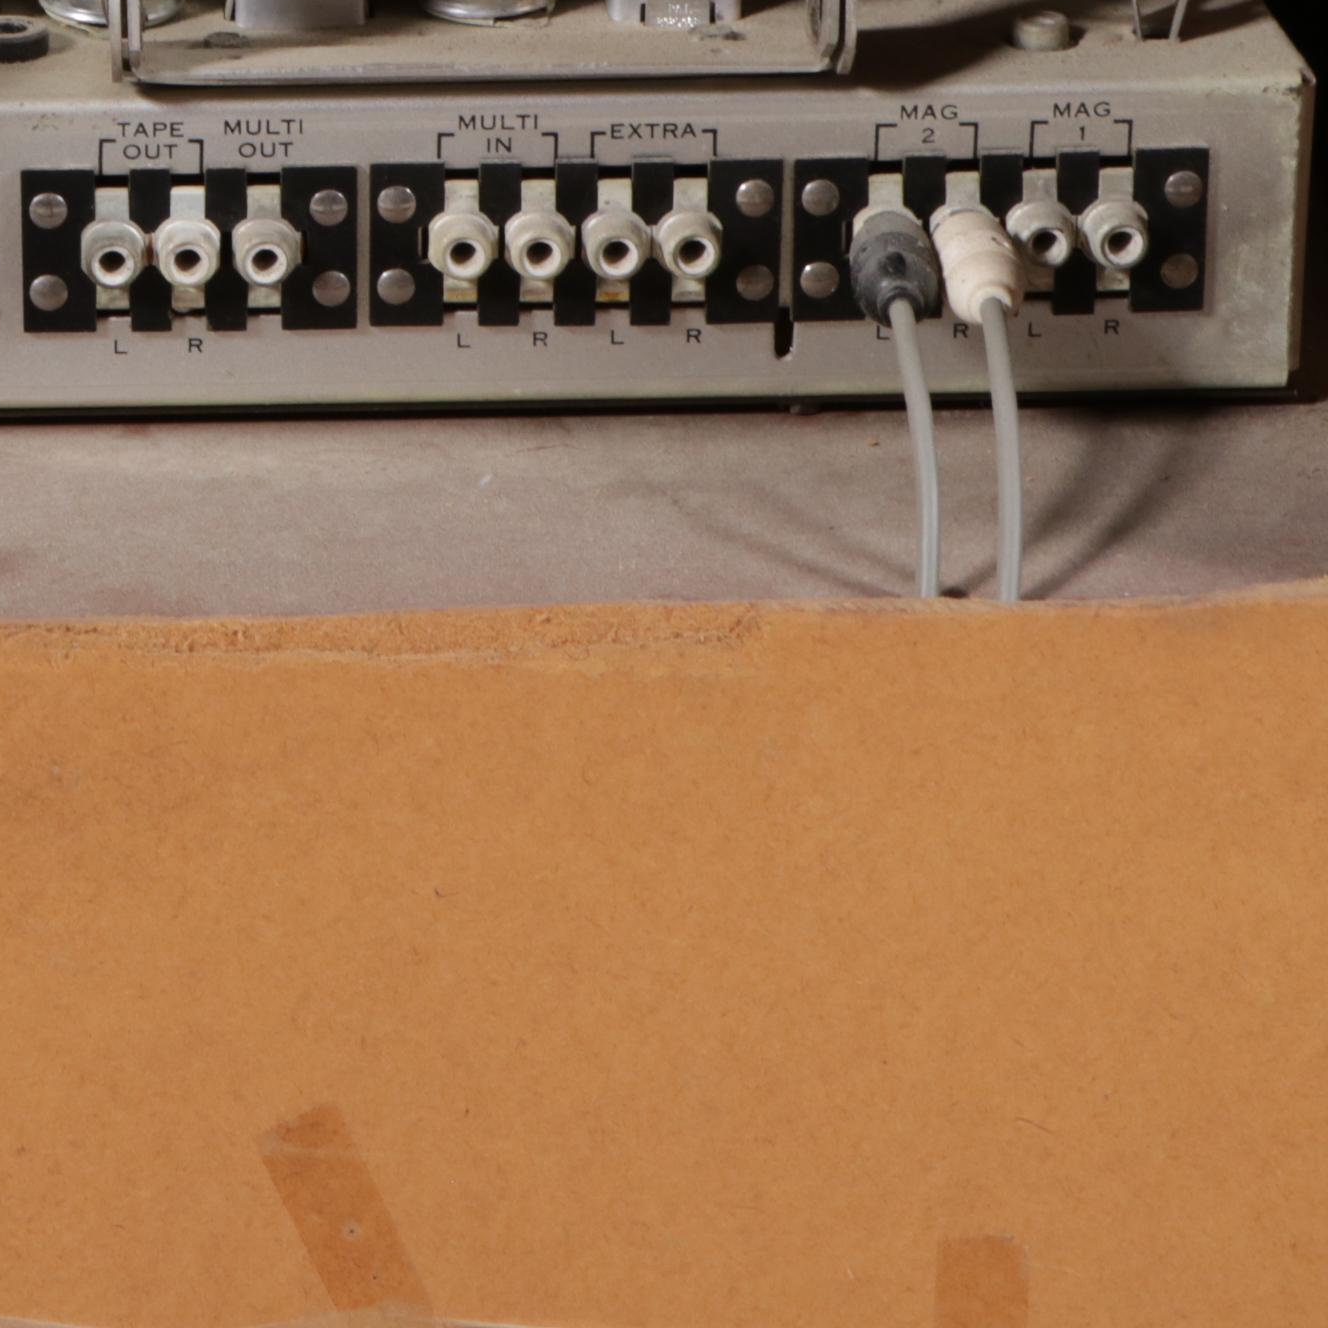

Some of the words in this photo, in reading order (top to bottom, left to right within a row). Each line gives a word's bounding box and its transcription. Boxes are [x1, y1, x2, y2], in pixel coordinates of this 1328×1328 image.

[900, 103, 959, 120] MAG
[1052, 101, 1112, 118] MAG
[115, 121, 185, 138] TAPE
[223, 118, 304, 136] MULTI
[458, 113, 539, 131] MULTI
[610, 122, 697, 140] EXTRA
[921, 127, 935, 145] 2
[1079, 125, 1086, 141] 1
[122, 143, 179, 161] OUT
[237, 141, 294, 159] OUT
[486, 137, 512, 153] IN
[952, 321, 970, 339] R
[1027, 321, 1042, 339] L
[1103, 318, 1120, 335] R
[113, 339, 128, 355] L
[187, 337, 204, 353] R
[456, 333, 471, 349] L
[532, 331, 549, 347] R
[610, 329, 625, 346] L
[685, 328, 702, 344] R
